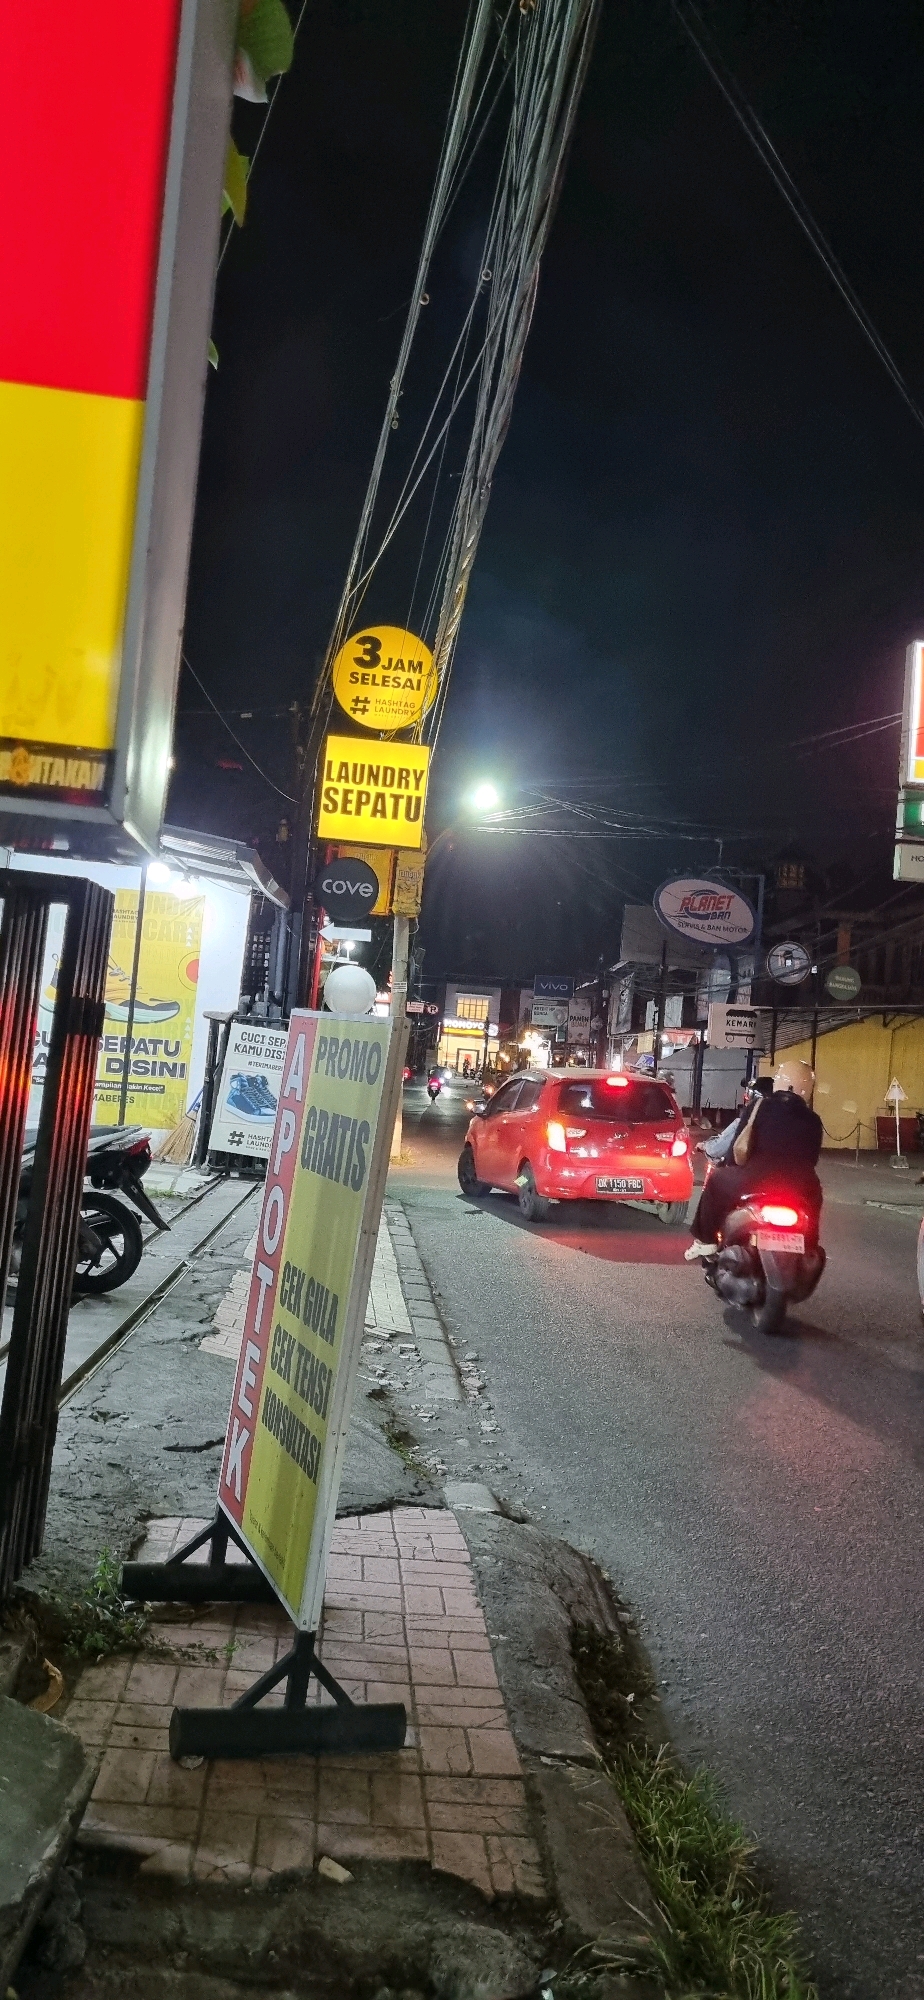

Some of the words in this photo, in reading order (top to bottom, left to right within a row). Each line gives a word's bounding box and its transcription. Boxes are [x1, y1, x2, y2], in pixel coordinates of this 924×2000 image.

[353, 635, 382, 669] 3
[381, 657, 423, 674] JAM
[349, 671, 421, 691] SELESAI
[374, 707, 416, 716] LAUNDRY
[375, 698, 416, 709] HASHTAG
[325, 760, 425, 791] LAUNDRY
[322, 786, 422, 822] SEPATU
[322, 879, 374, 897] cove
[680, 894, 736, 912] PLANET
[723, 925, 749, 934] MOTOR
[541, 982, 569, 991] vivo
[726, 1019, 757, 1029] KEMARI
[234, 1042, 263, 1056] KAMU
[241, 1031, 266, 1044] CUCI
[267, 1036, 287, 1048] SEP
[315, 1036, 381, 1086] PROMO
[301, 1105, 371, 1193] GRATIS
[225, 1033, 306, 1501] APOTEK
[280, 1261, 306, 1319] CEK
[303, 1276, 338, 1347] GULA
[270, 1324, 296, 1384] CEK
[294, 1342, 332, 1421] TENSI
[262, 1386, 322, 1485] KONSULTASI
